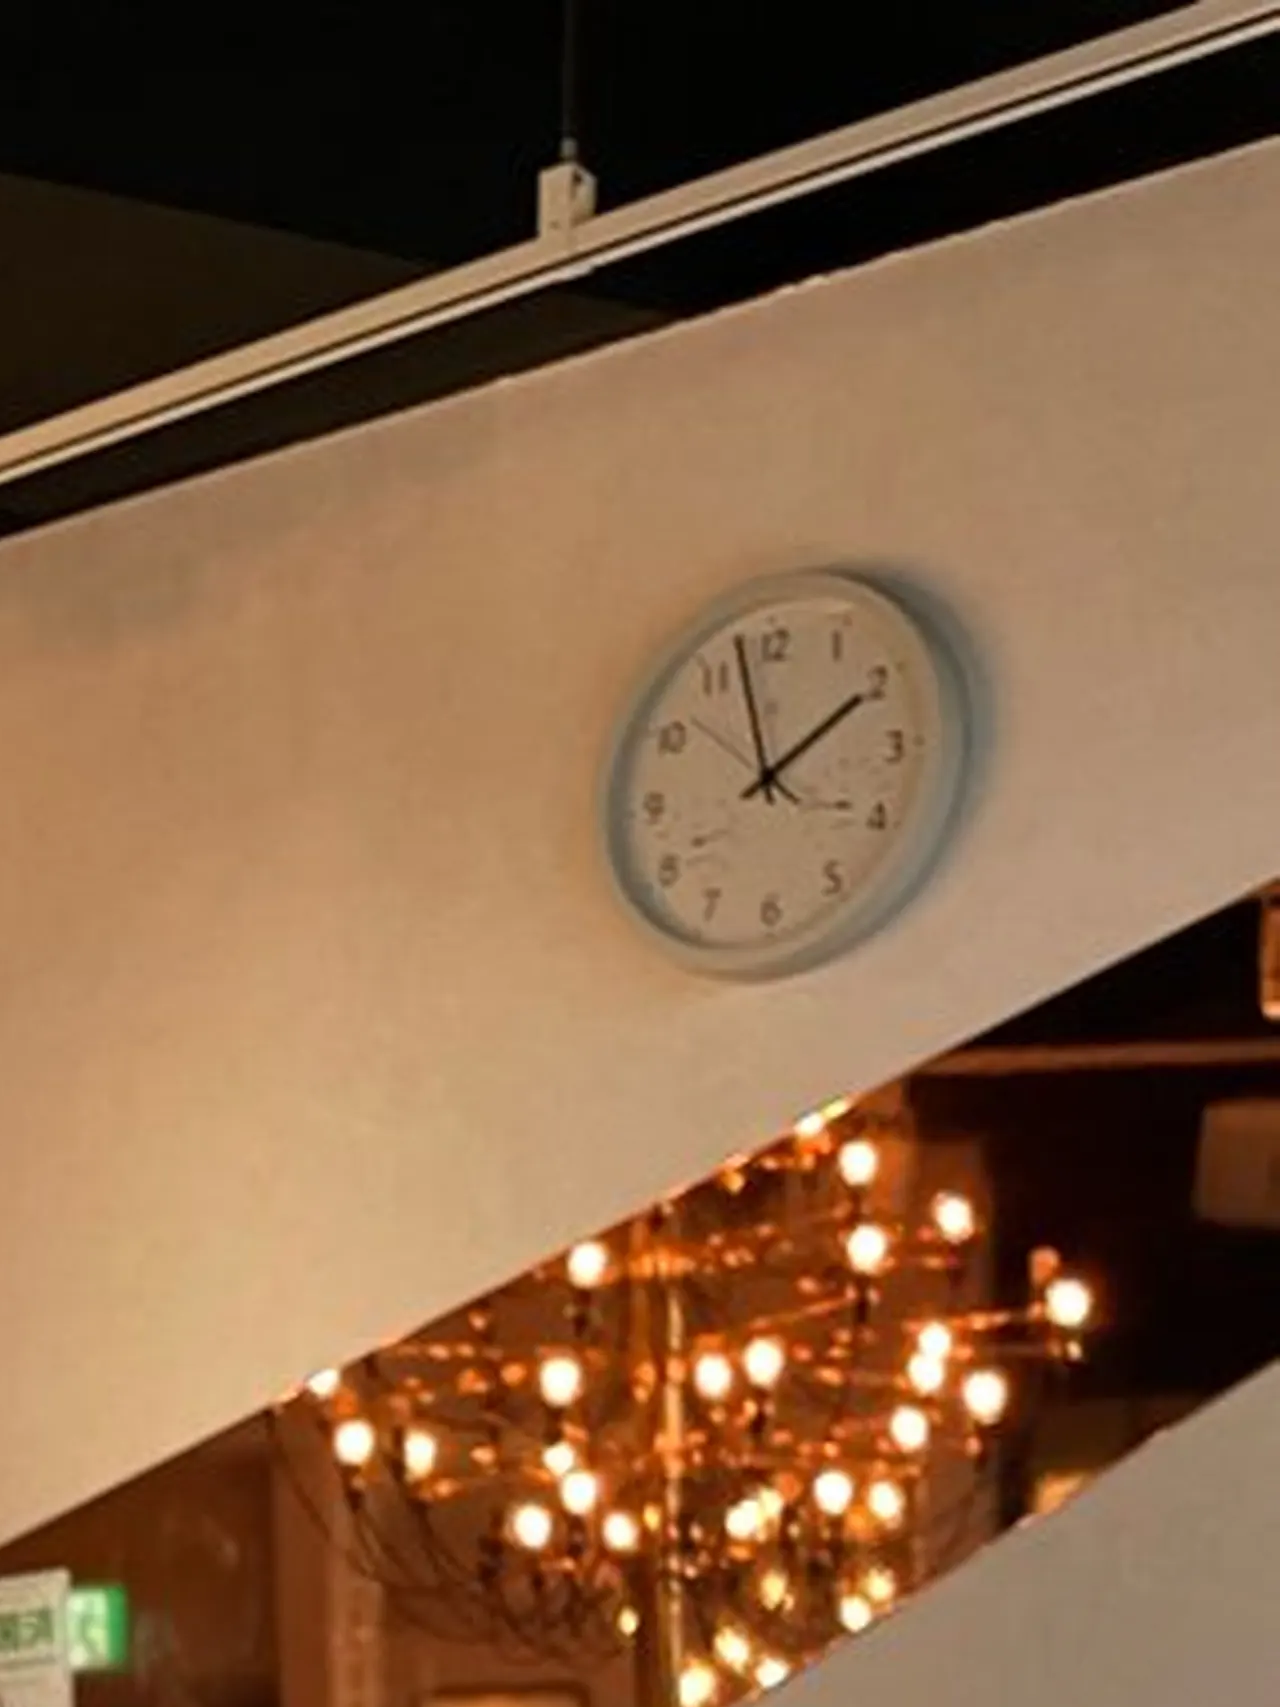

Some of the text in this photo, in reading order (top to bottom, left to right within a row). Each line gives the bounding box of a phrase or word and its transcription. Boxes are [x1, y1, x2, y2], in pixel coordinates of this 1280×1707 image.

[761, 628, 790, 662] 12
[831, 629, 843, 661] 1
[701, 661, 730, 697] 11
[866, 665, 889, 699] 2
[658, 721, 687, 755] 10
[886, 730, 904, 764] 3
[643, 793, 665, 825] 9
[866, 803, 887, 831] 4
[658, 854, 680, 887] 8
[823, 860, 843, 895] 5
[702, 887, 721, 921] 7
[760, 894, 782, 926] 6
